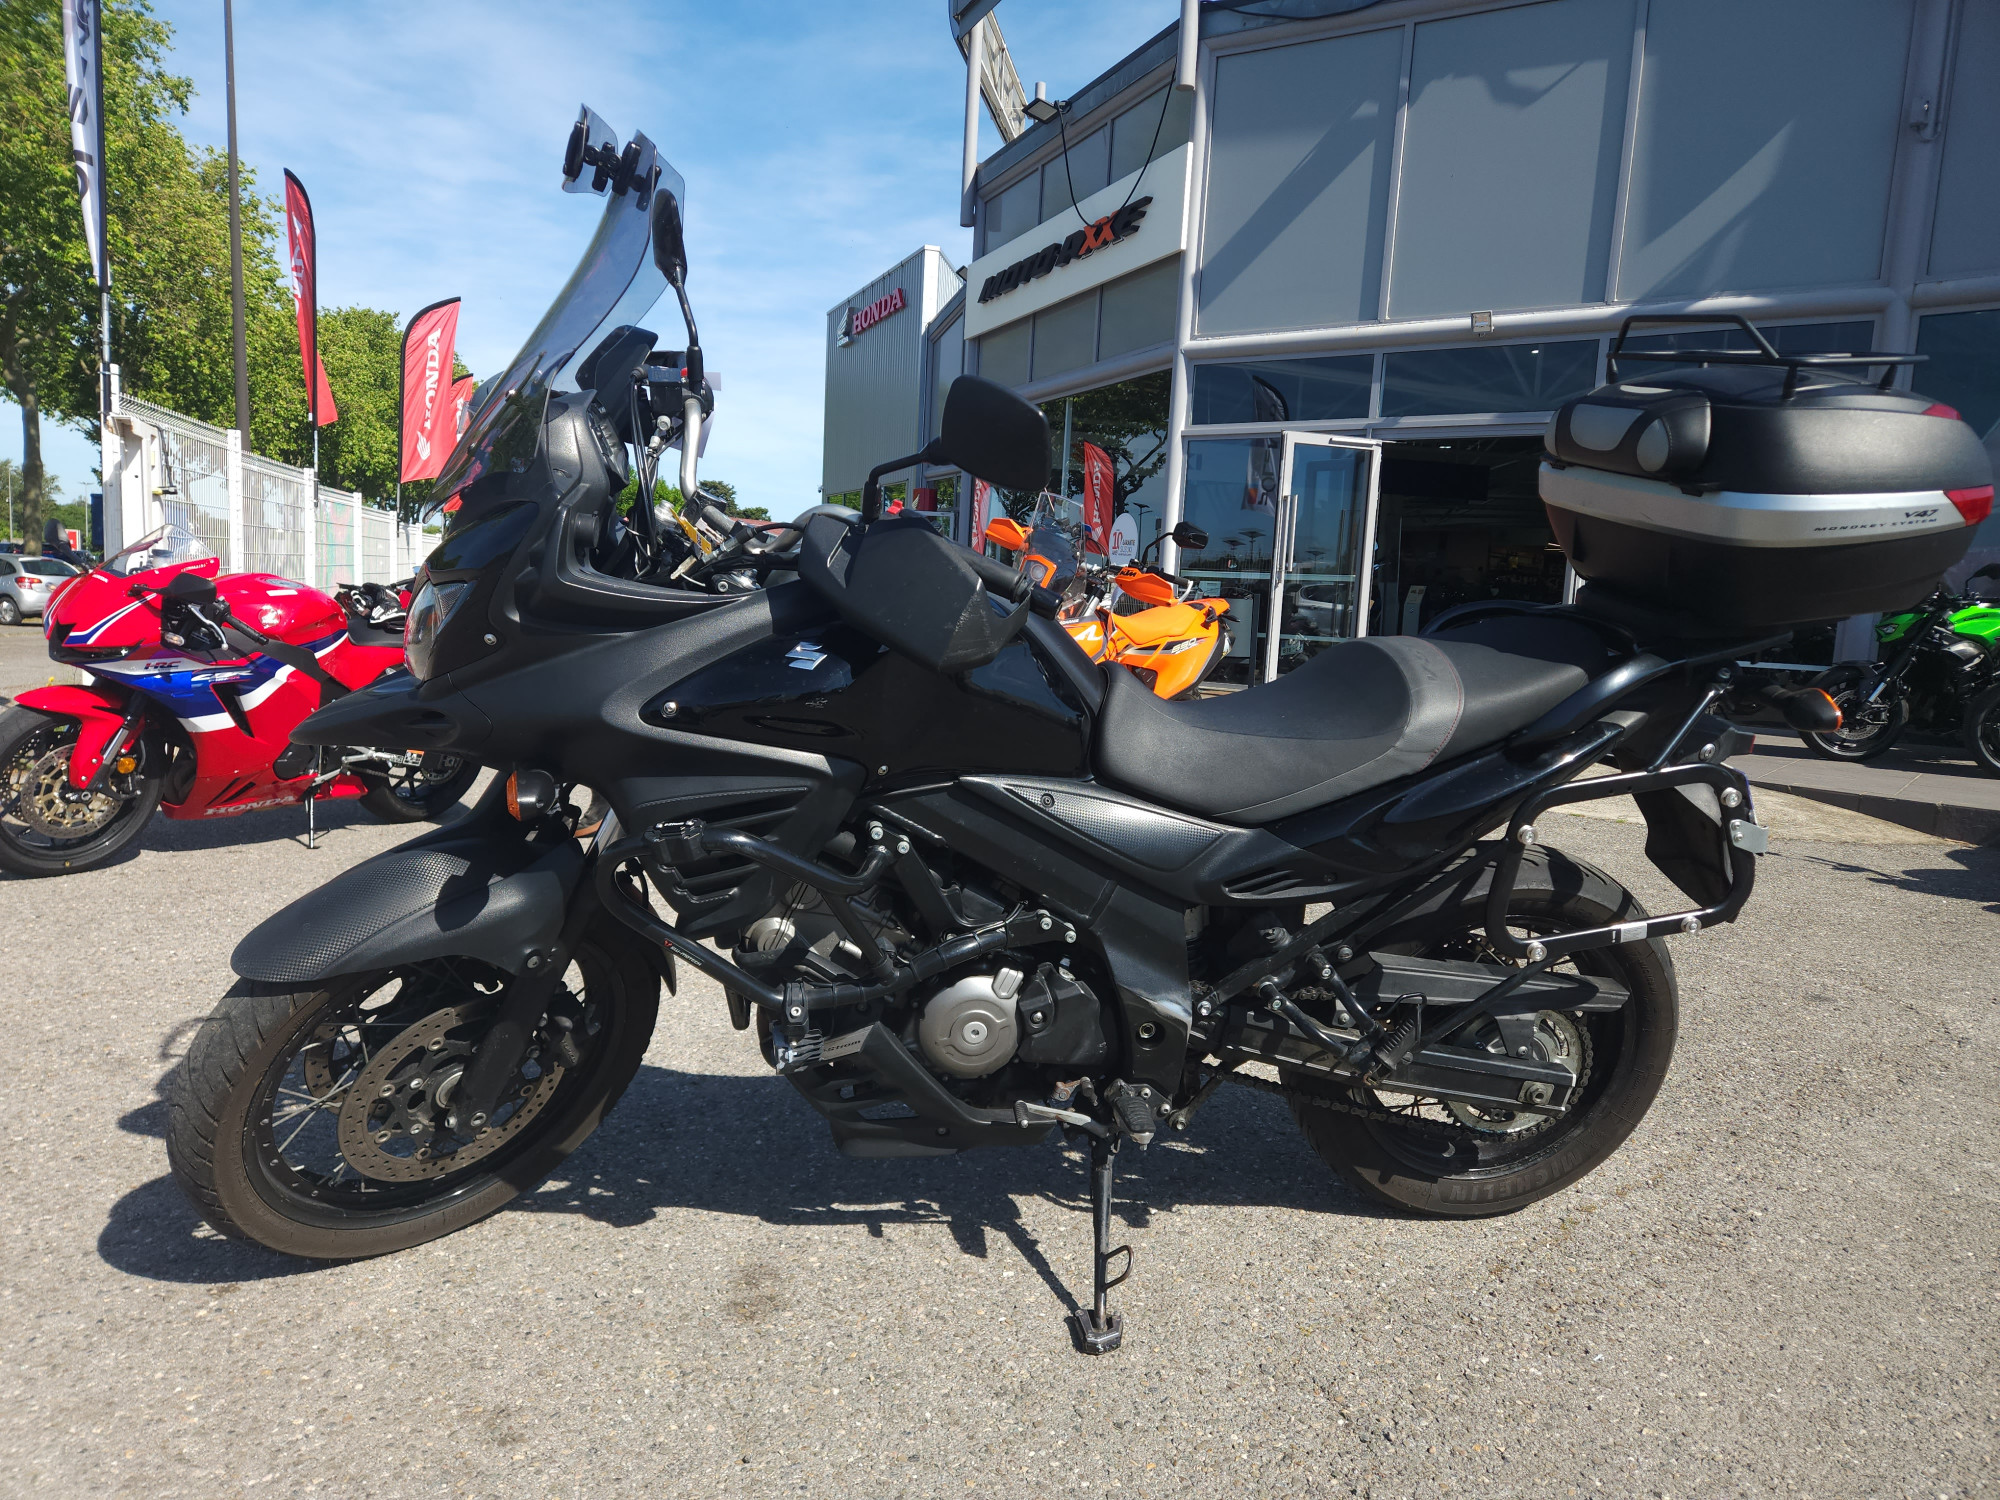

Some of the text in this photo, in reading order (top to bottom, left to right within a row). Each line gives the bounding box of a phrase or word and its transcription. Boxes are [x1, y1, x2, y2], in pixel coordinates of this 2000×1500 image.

[852, 288, 905, 335] HONDA
[1904, 508, 1939, 518] V47
[1814, 518, 1937, 532] MONOKEY SYSTEM
[1120, 569, 1138, 577] KTM
[144, 661, 182, 670] HRC
[204, 796, 296, 816] HONDA
[1448, 1147, 1585, 1202] MICHELIN
